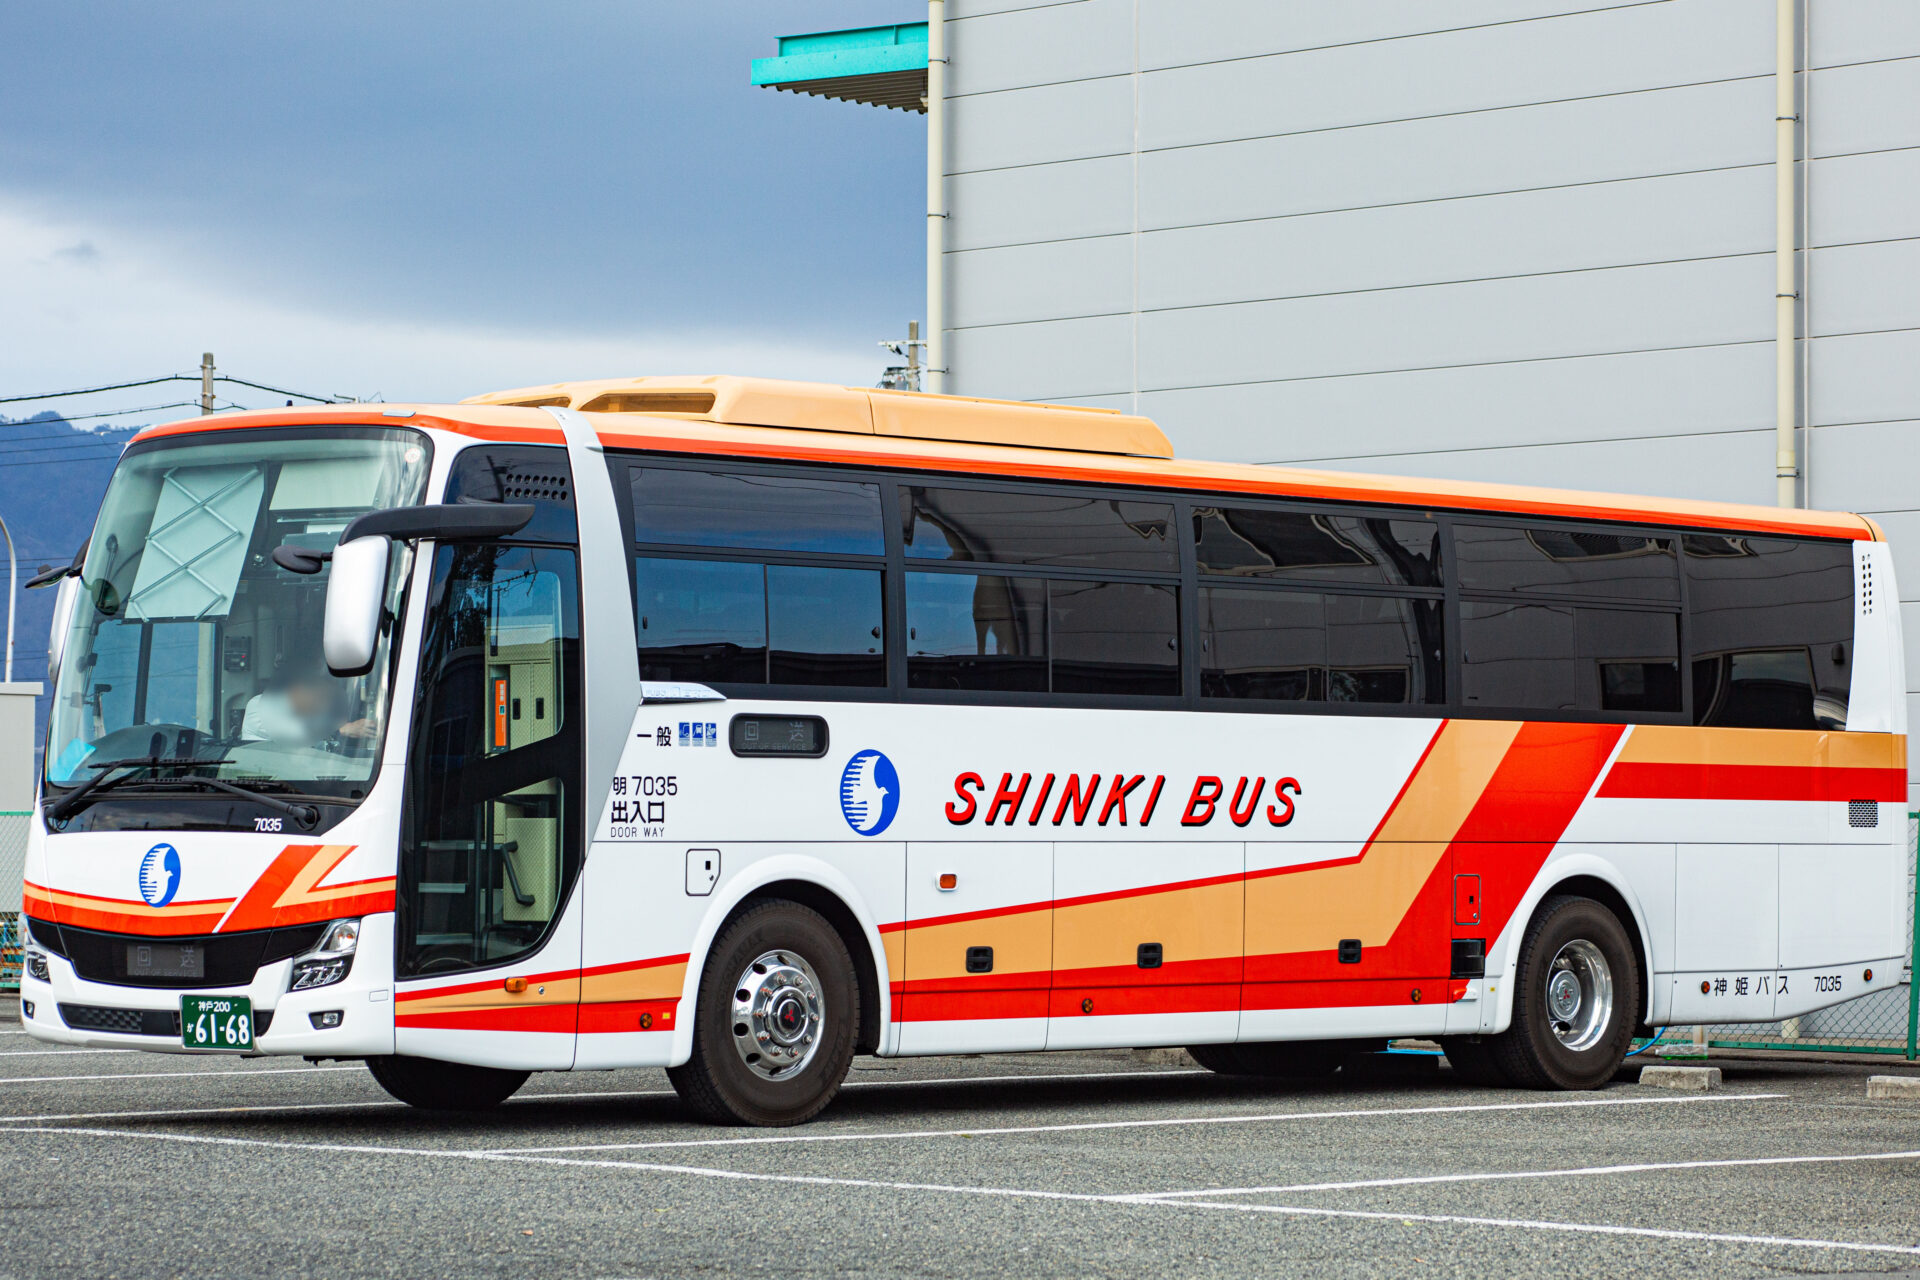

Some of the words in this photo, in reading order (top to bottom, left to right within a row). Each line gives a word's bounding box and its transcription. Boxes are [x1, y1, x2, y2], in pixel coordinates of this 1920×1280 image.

[637, 726, 671, 747] 一般
[631, 776, 678, 796] 7035
[945, 772, 1166, 827] SHINKI
[1180, 776, 1302, 828] BUS
[611, 801, 665, 823] 出入口
[253, 817, 283, 832] 7035
[610, 827, 637, 838] DOOR
[643, 827, 665, 838] WAY
[1713, 975, 1790, 997] 神姫バス
[1813, 975, 1842, 993] 7035
[195, 1013, 250, 1045] 61-68
